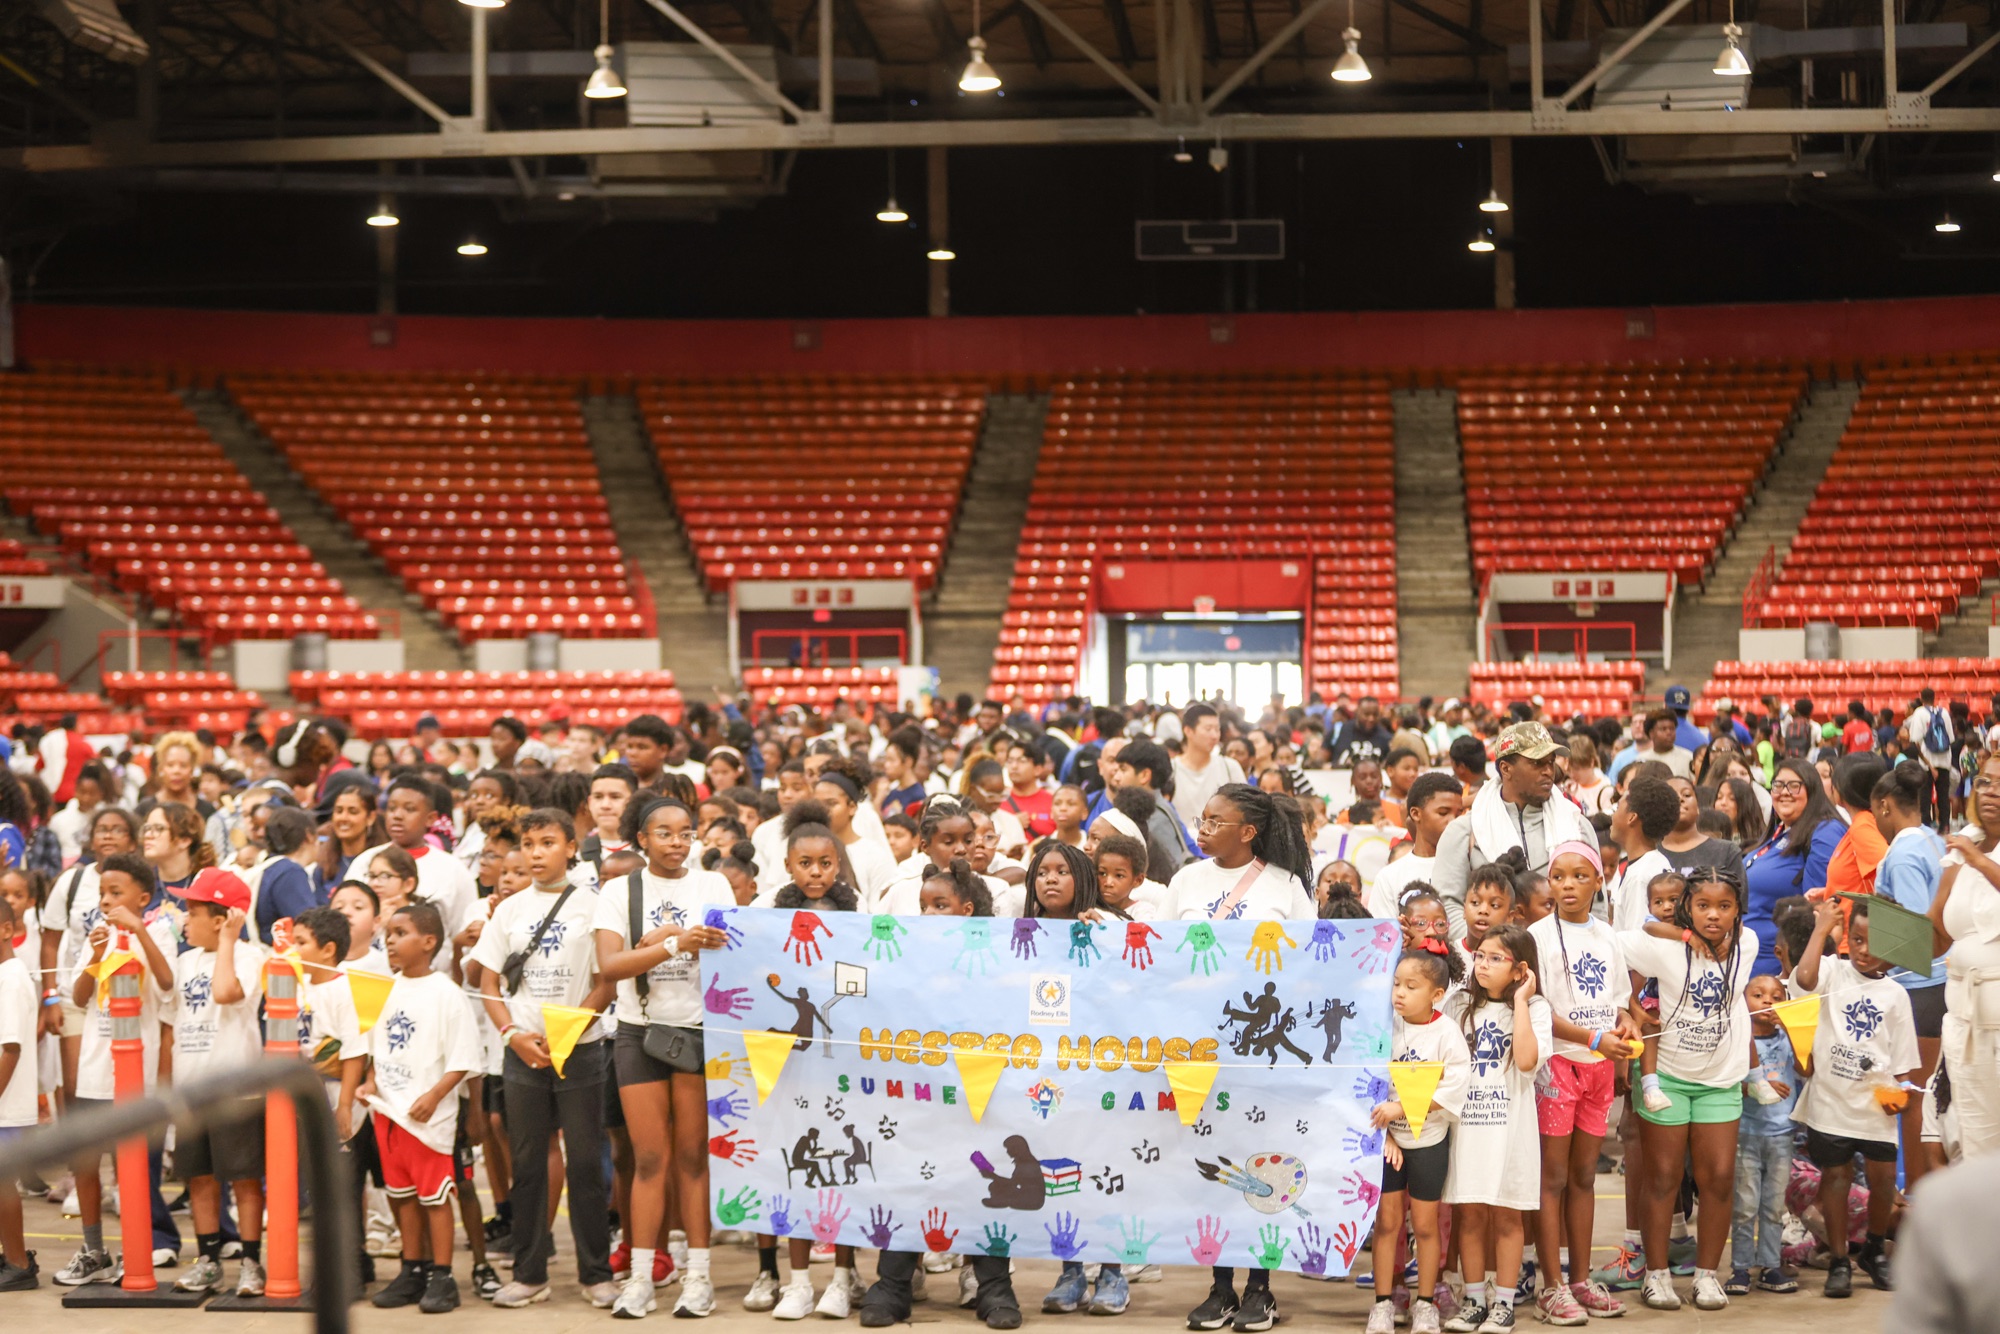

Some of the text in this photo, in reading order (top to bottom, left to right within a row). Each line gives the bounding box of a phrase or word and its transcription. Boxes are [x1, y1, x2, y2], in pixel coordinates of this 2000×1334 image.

[1031, 1010, 1054, 1018] Rodney
[859, 1027, 1219, 1073] HESTER HOUSE
[838, 1074, 1230, 1111] SUMME GAMS
[1461, 1111, 1489, 1120] Rodney
